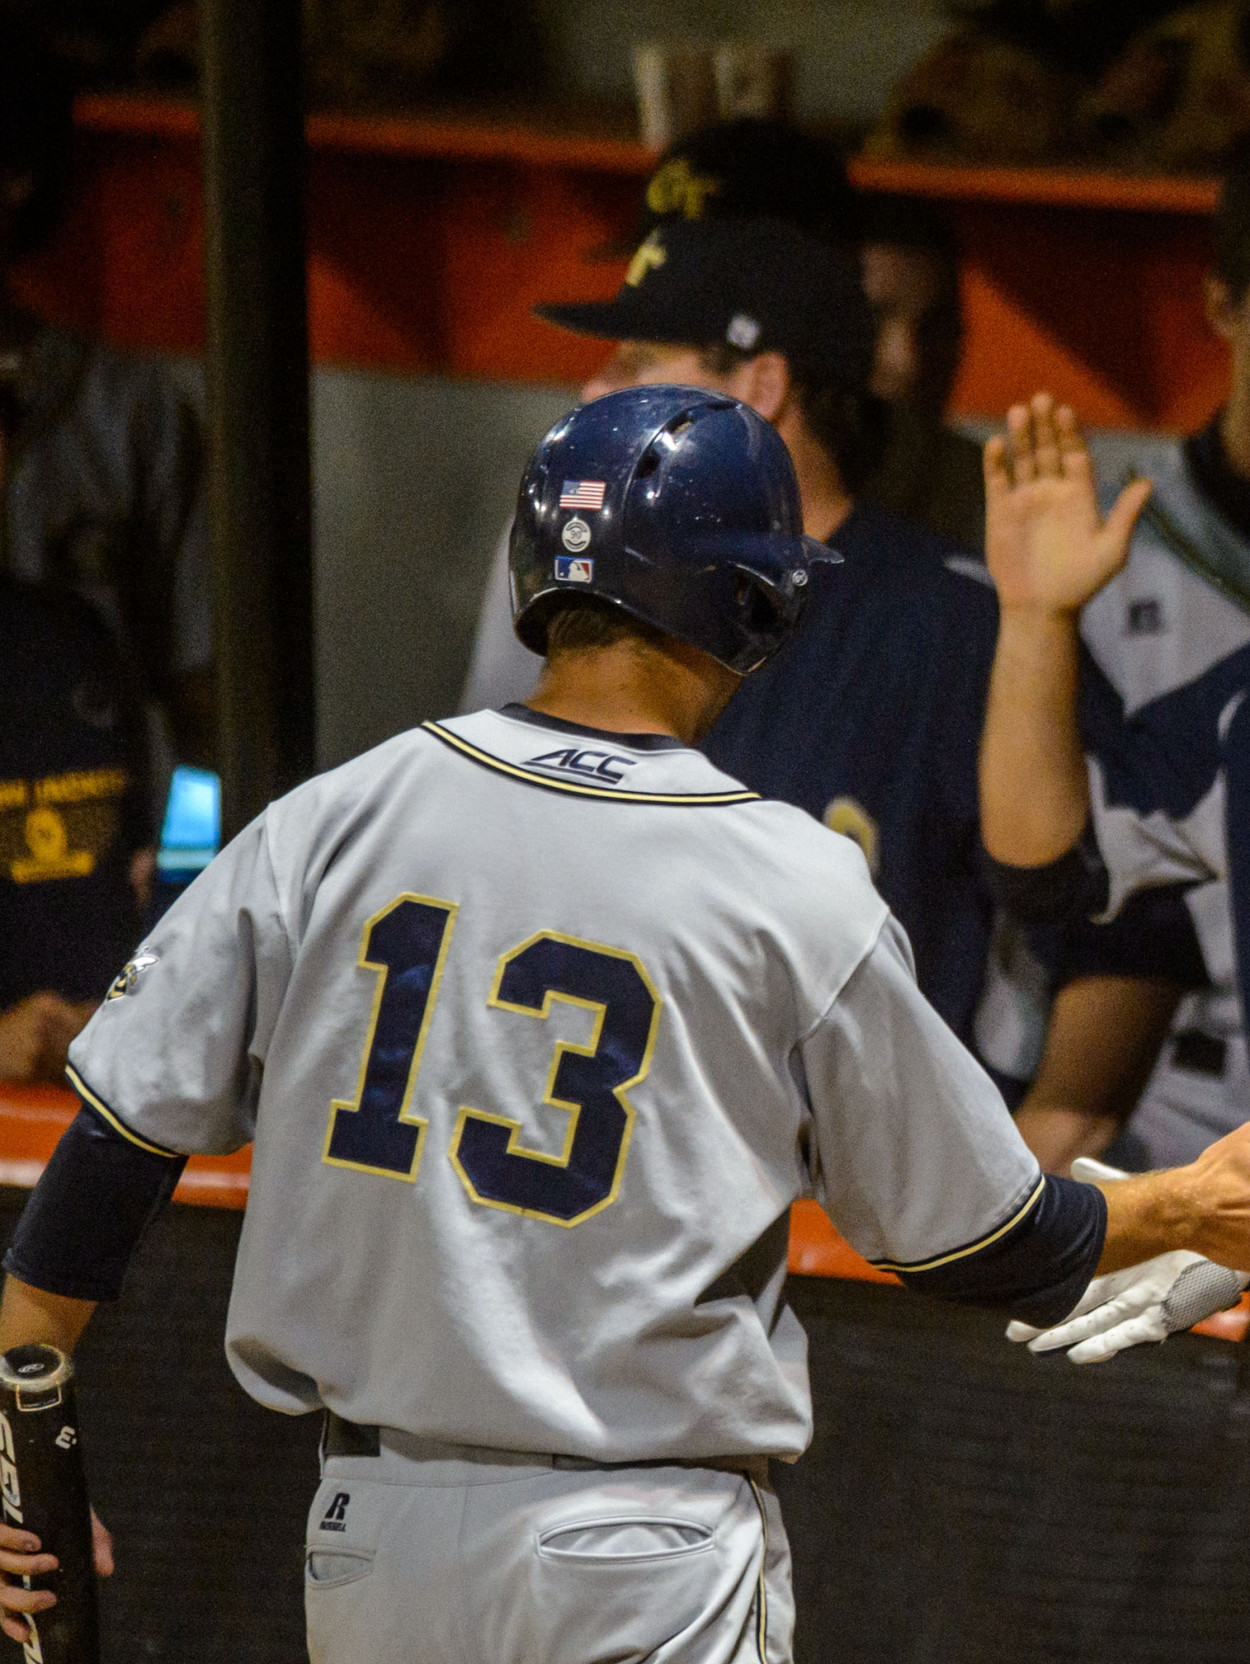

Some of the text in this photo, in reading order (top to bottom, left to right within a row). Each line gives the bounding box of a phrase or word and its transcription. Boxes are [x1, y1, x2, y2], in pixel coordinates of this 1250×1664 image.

[522, 749, 637, 784] ACC
[322, 891, 663, 1229] 13
[324, 1493, 350, 1520] R
